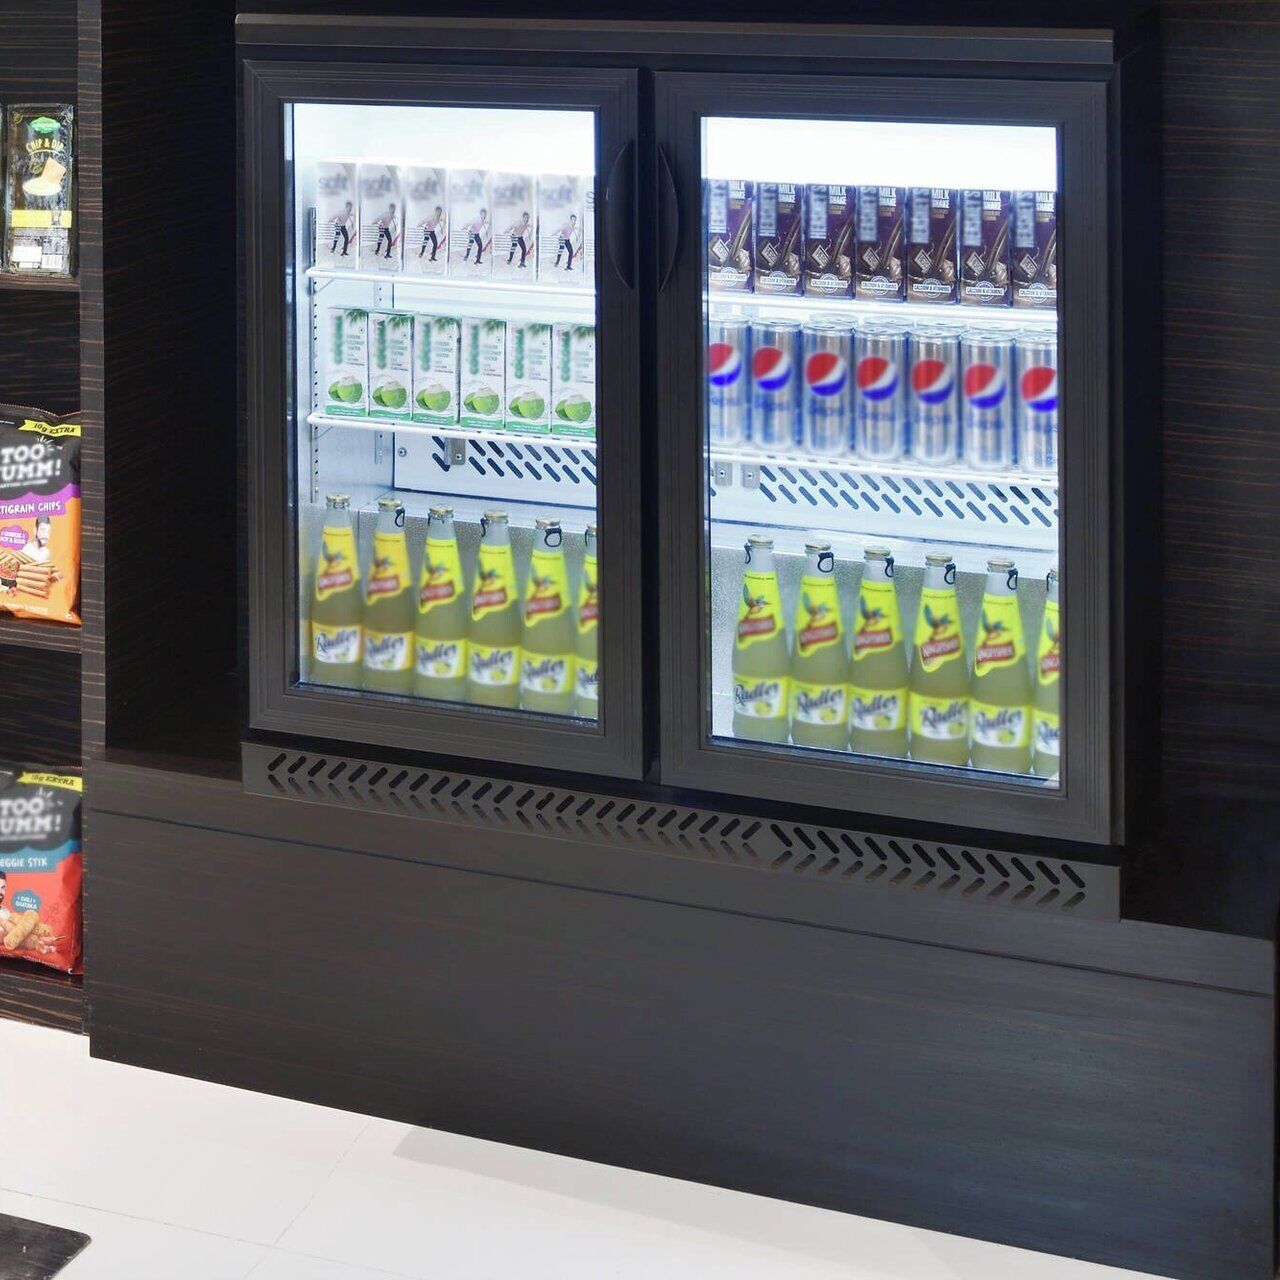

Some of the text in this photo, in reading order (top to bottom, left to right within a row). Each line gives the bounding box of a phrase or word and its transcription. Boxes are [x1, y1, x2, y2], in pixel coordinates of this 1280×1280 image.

[26, 138, 42, 151] CHIP
[50, 138, 65, 151] DIP
[779, 184, 795, 194] MILK
[829, 186, 846, 195] MILK
[879, 187, 896, 197] MILK
[932, 190, 949, 199] MILK
[983, 191, 1001, 201] MILK
[1036, 192, 1054, 202] MILK
[49, 425, 75, 435] EXTRA
[0, 444, 45, 463] TOO
[37, 500, 62, 512] CHIPS
[315, 626, 357, 654] Radler
[735, 682, 778, 706] Radler
[797, 688, 842, 713] Radler
[28, 857, 47, 867] STIX
